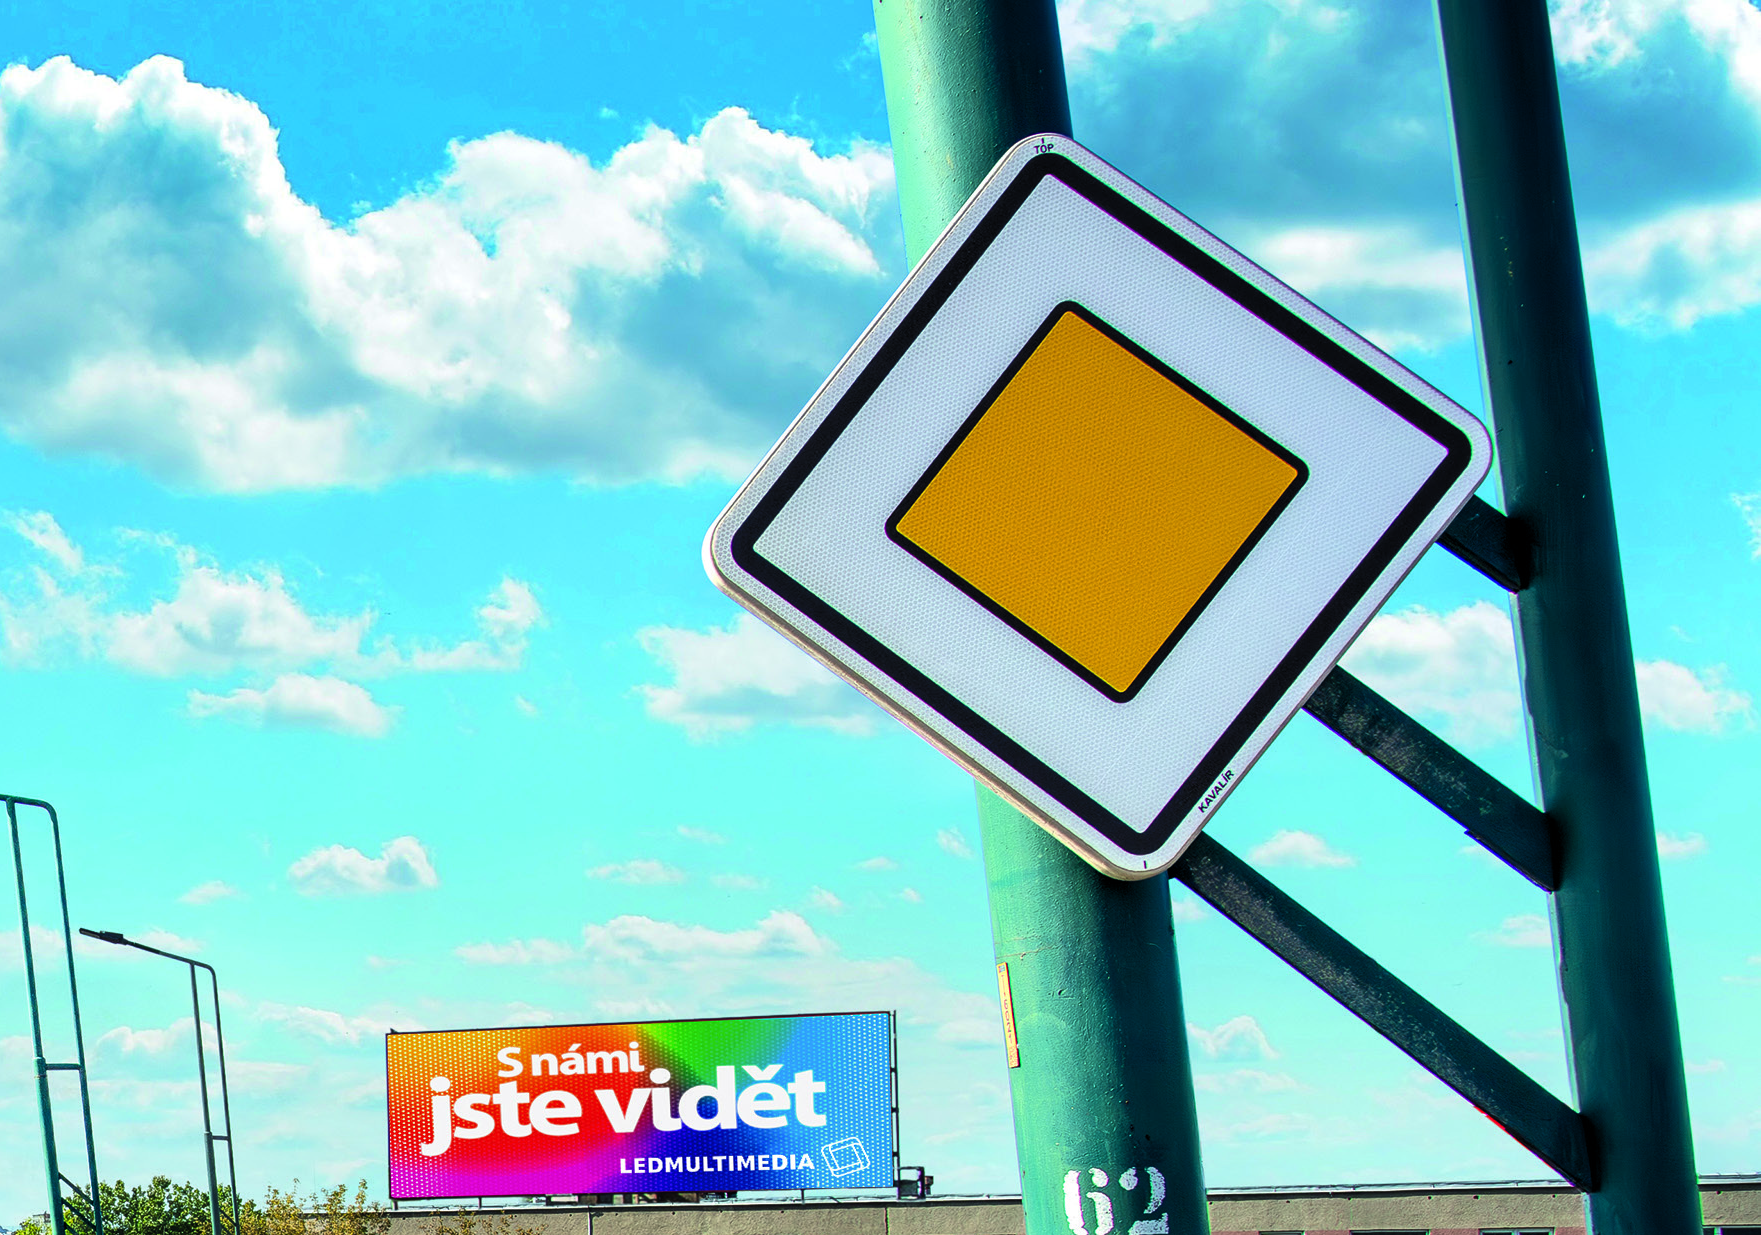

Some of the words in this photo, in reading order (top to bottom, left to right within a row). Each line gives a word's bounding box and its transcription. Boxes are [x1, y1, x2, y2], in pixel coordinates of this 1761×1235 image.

[1034, 143, 1055, 154] TOP
[1197, 769, 1235, 813] KAVALÍR
[497, 1046, 524, 1078] S
[531, 1042, 645, 1077] námi
[420, 1075, 583, 1157] jste
[594, 1063, 827, 1134] vidět
[620, 1153, 815, 1175] LEDMULTIMEDIA
